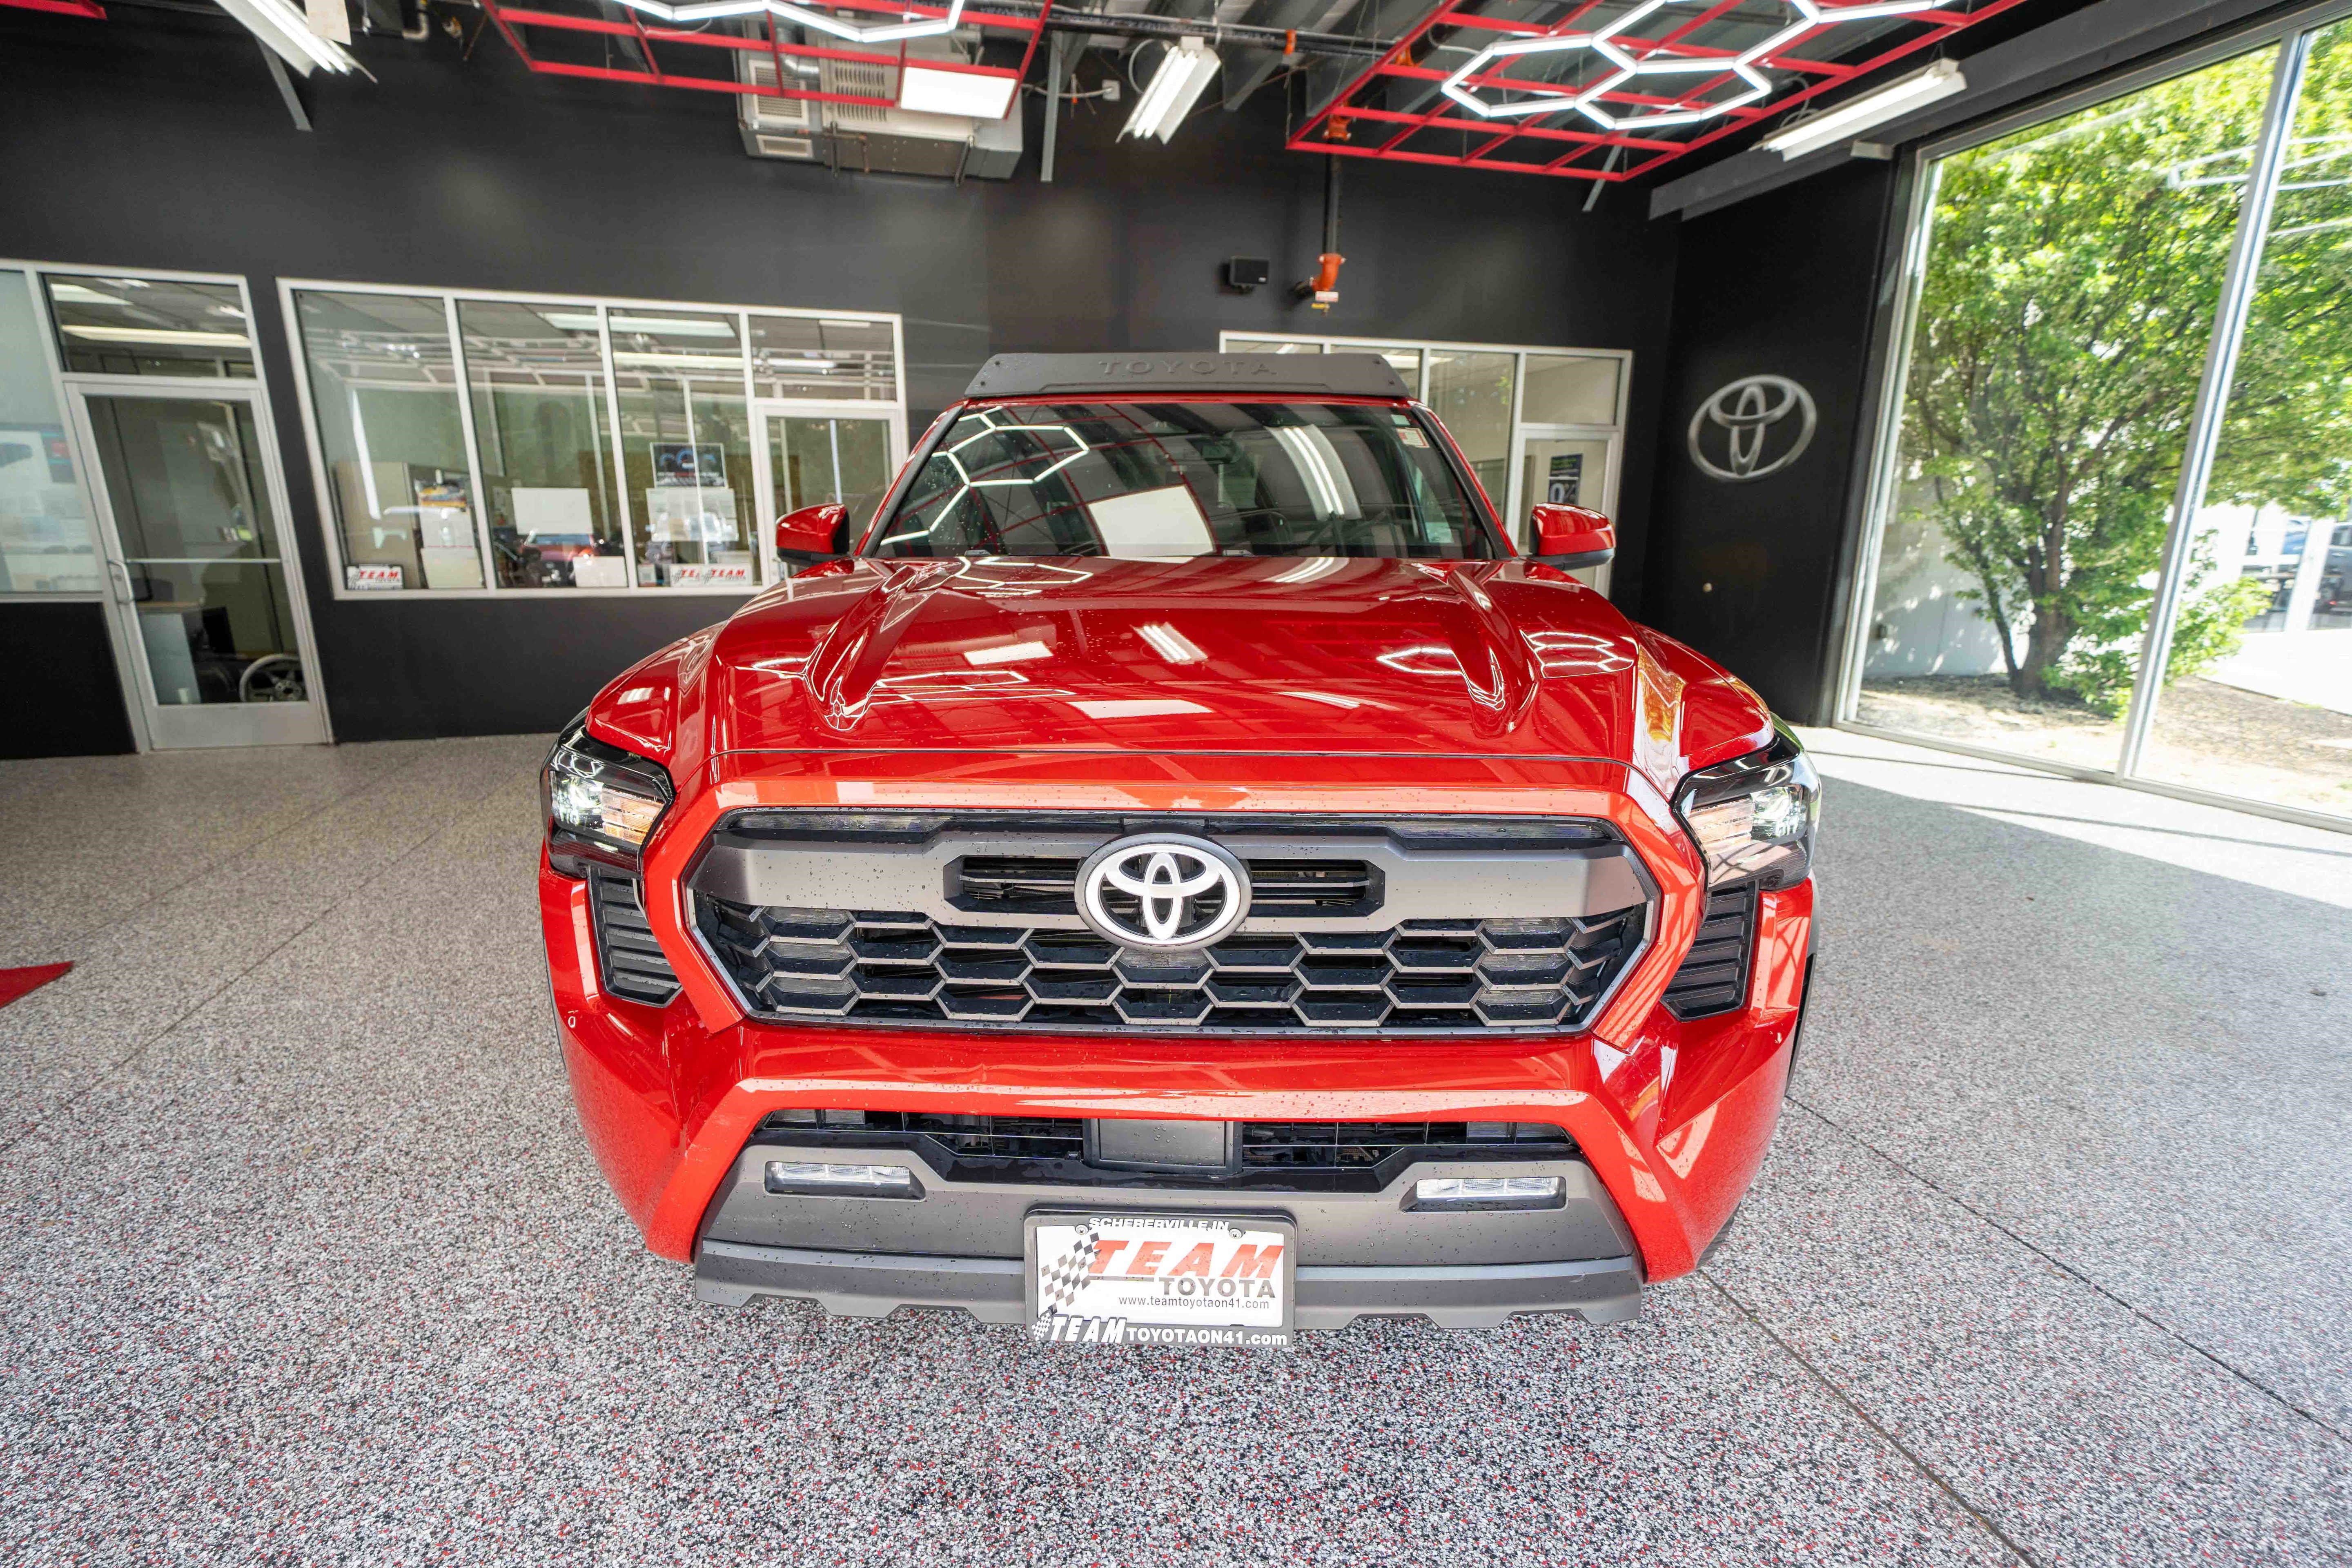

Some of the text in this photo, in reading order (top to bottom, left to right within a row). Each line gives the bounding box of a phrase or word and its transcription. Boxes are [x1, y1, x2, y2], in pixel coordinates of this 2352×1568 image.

[1098, 360, 1278, 375] TOYOTA
[359, 570, 399, 579] TEAM
[1088, 1240, 1284, 1278] TEAM
[1158, 1277, 1276, 1298] TOYOTA
[1118, 1296, 1270, 1309] www.teamtoyotaon41.com
